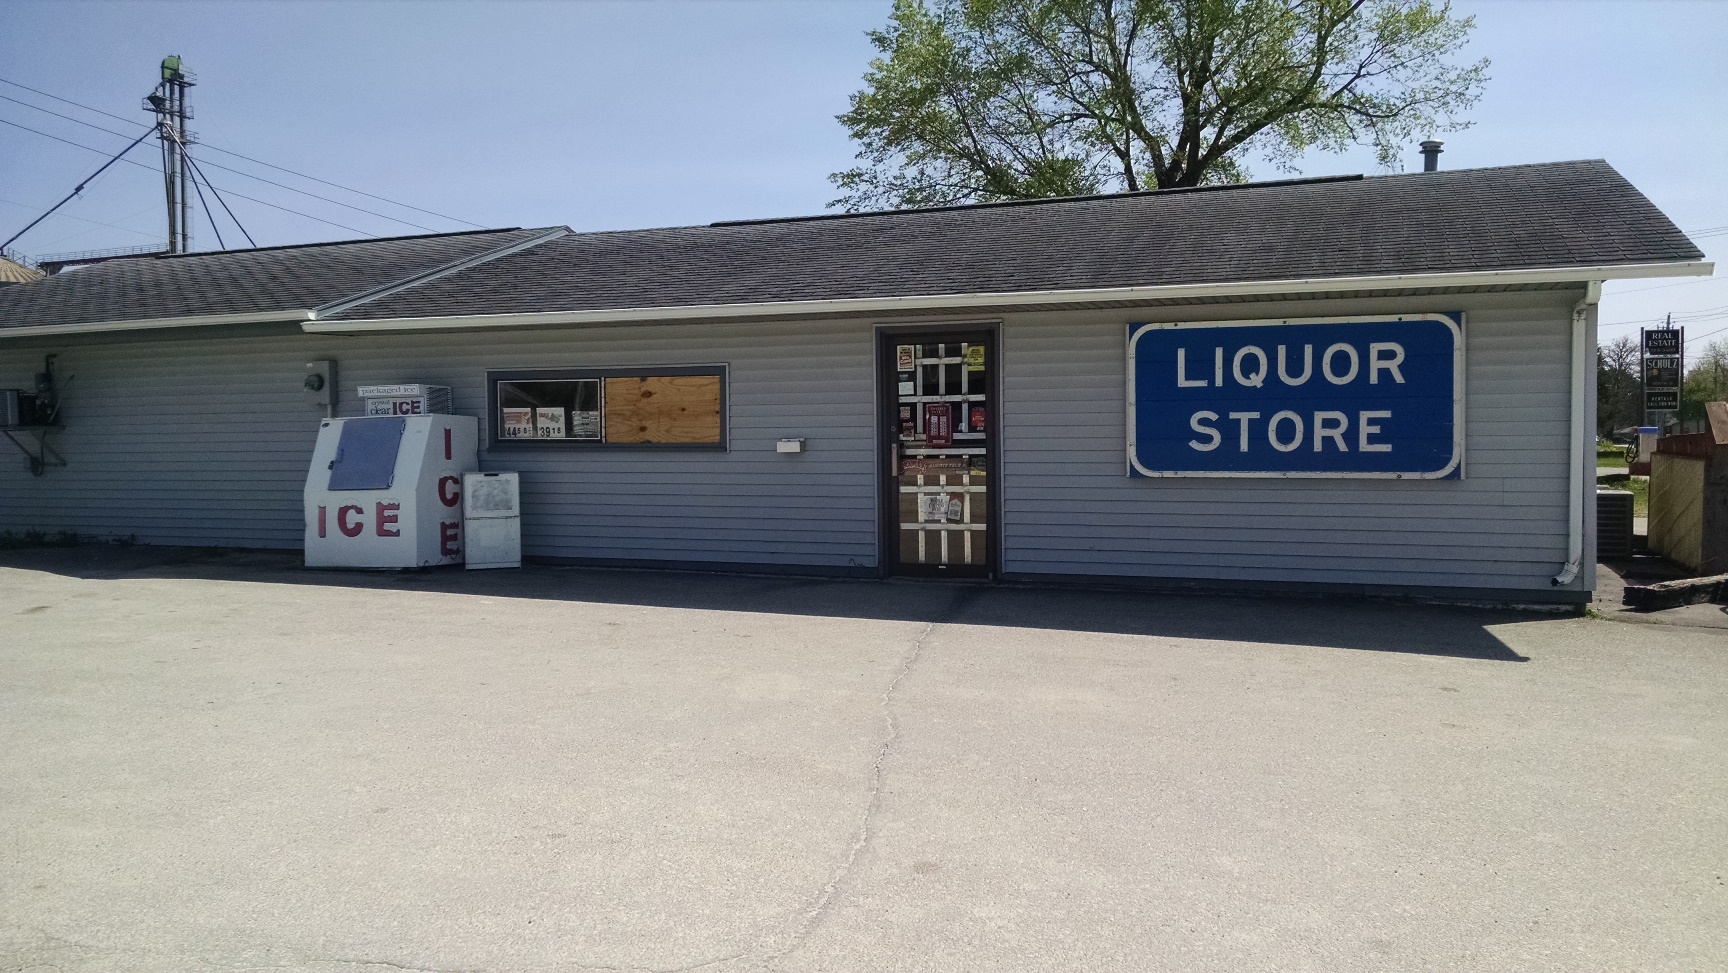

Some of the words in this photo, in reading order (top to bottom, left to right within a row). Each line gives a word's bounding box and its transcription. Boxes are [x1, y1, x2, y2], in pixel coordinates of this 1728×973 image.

[1177, 342, 1406, 389] LIQUOR
[1647, 358, 1678, 369] SCHULZ
[361, 386, 401, 396] packaged
[370, 406, 391, 415] clear
[392, 400, 421, 416] ICE
[1188, 410, 1393, 452] STORE
[438, 427, 460, 558] ICE
[318, 500, 400, 538] ICE
